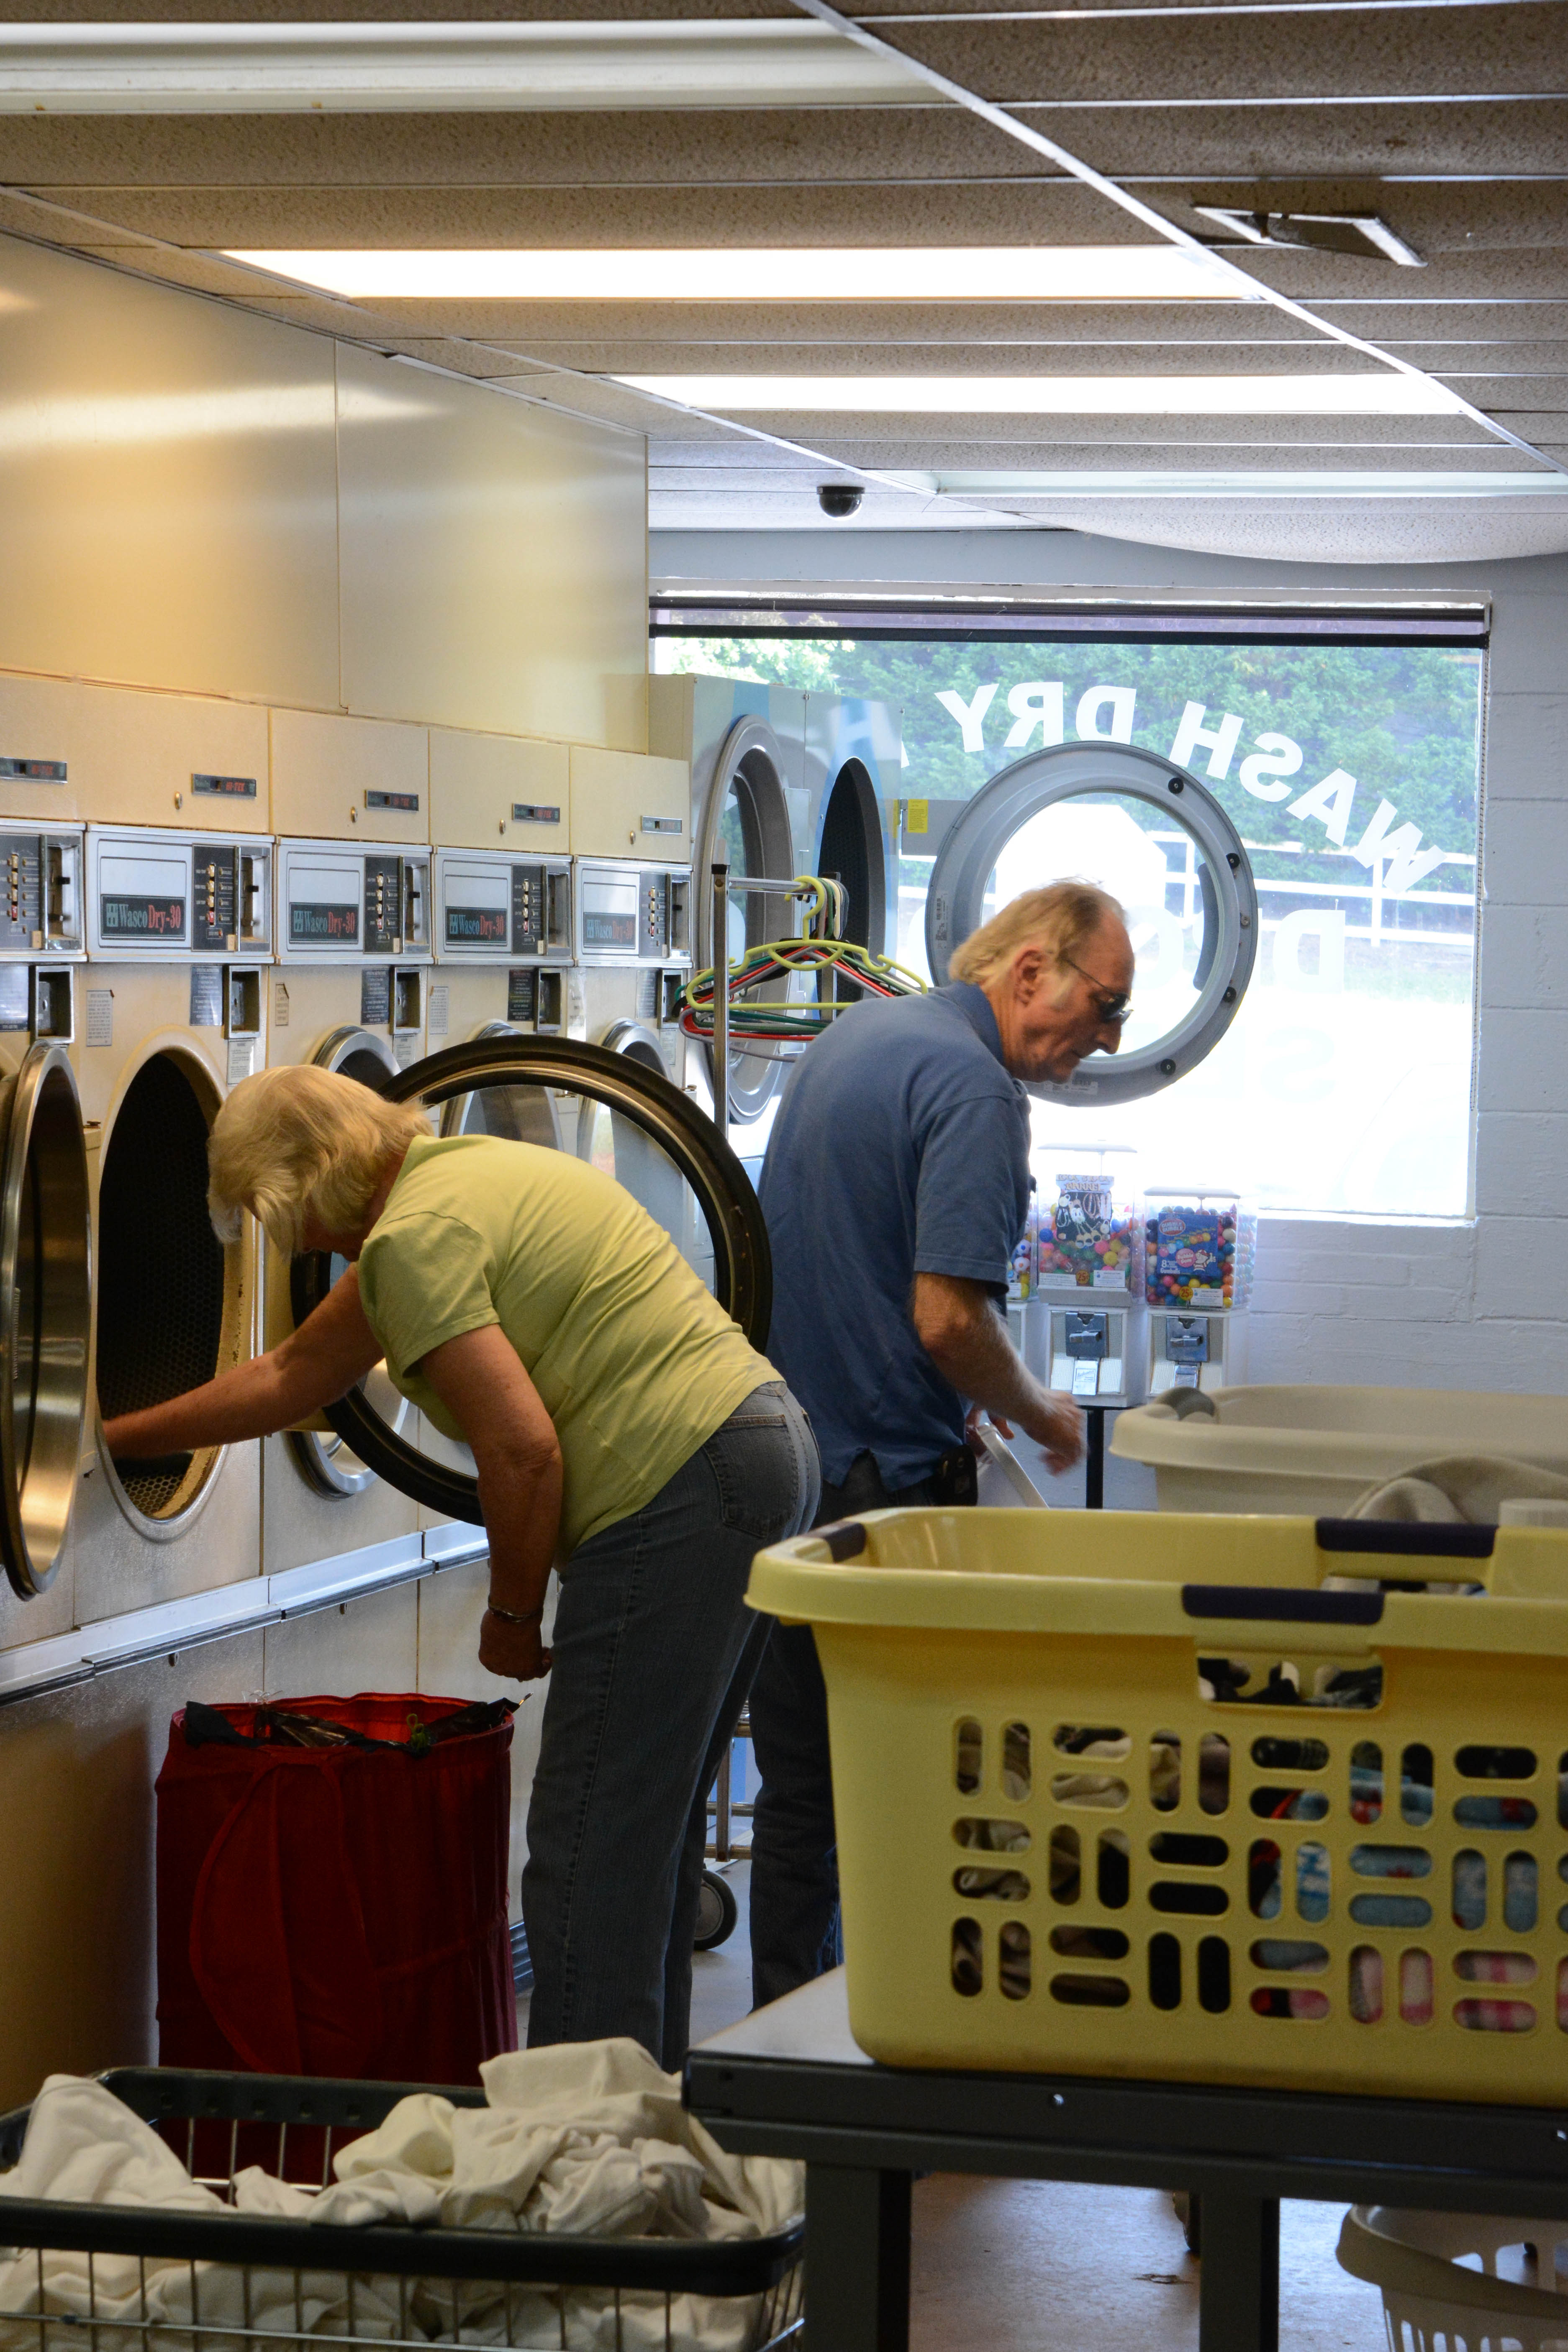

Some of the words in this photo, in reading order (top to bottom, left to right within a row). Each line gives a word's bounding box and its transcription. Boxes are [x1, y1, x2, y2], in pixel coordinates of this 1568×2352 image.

[119, 904, 148, 928] Wasco
[148, 904, 181, 934] Dry-30
[304, 911, 327, 933] Wasco
[328, 911, 355, 938] Dry-30
[458, 915, 480, 935] Wasco
[480, 915, 504, 940] Dry-30
[594, 920, 612, 939] Wasco
[1161, 1259, 1167, 1268] 8
